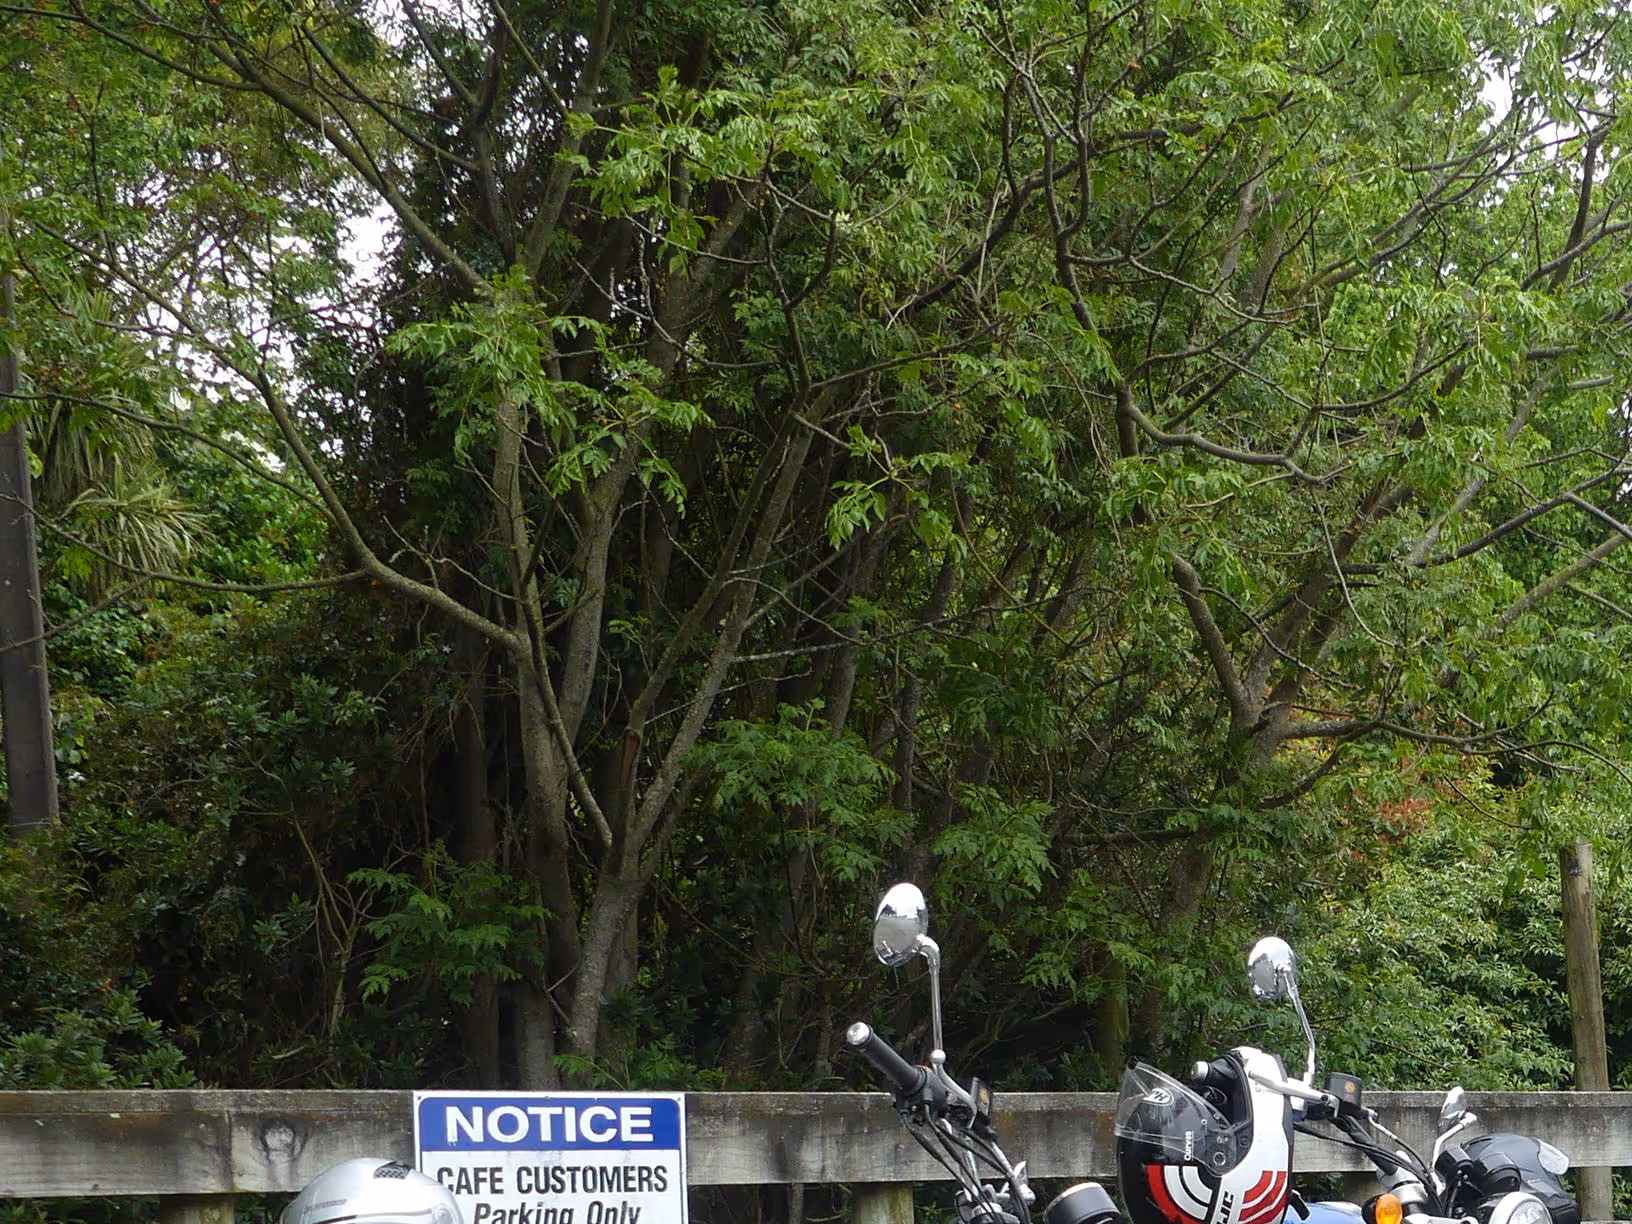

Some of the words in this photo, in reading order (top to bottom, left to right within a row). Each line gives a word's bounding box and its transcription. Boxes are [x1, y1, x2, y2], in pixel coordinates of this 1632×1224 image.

[446, 1106, 653, 1142] NOTICE
[437, 1167, 504, 1195] CAFE
[516, 1165, 668, 1194] CUSTOMERS
